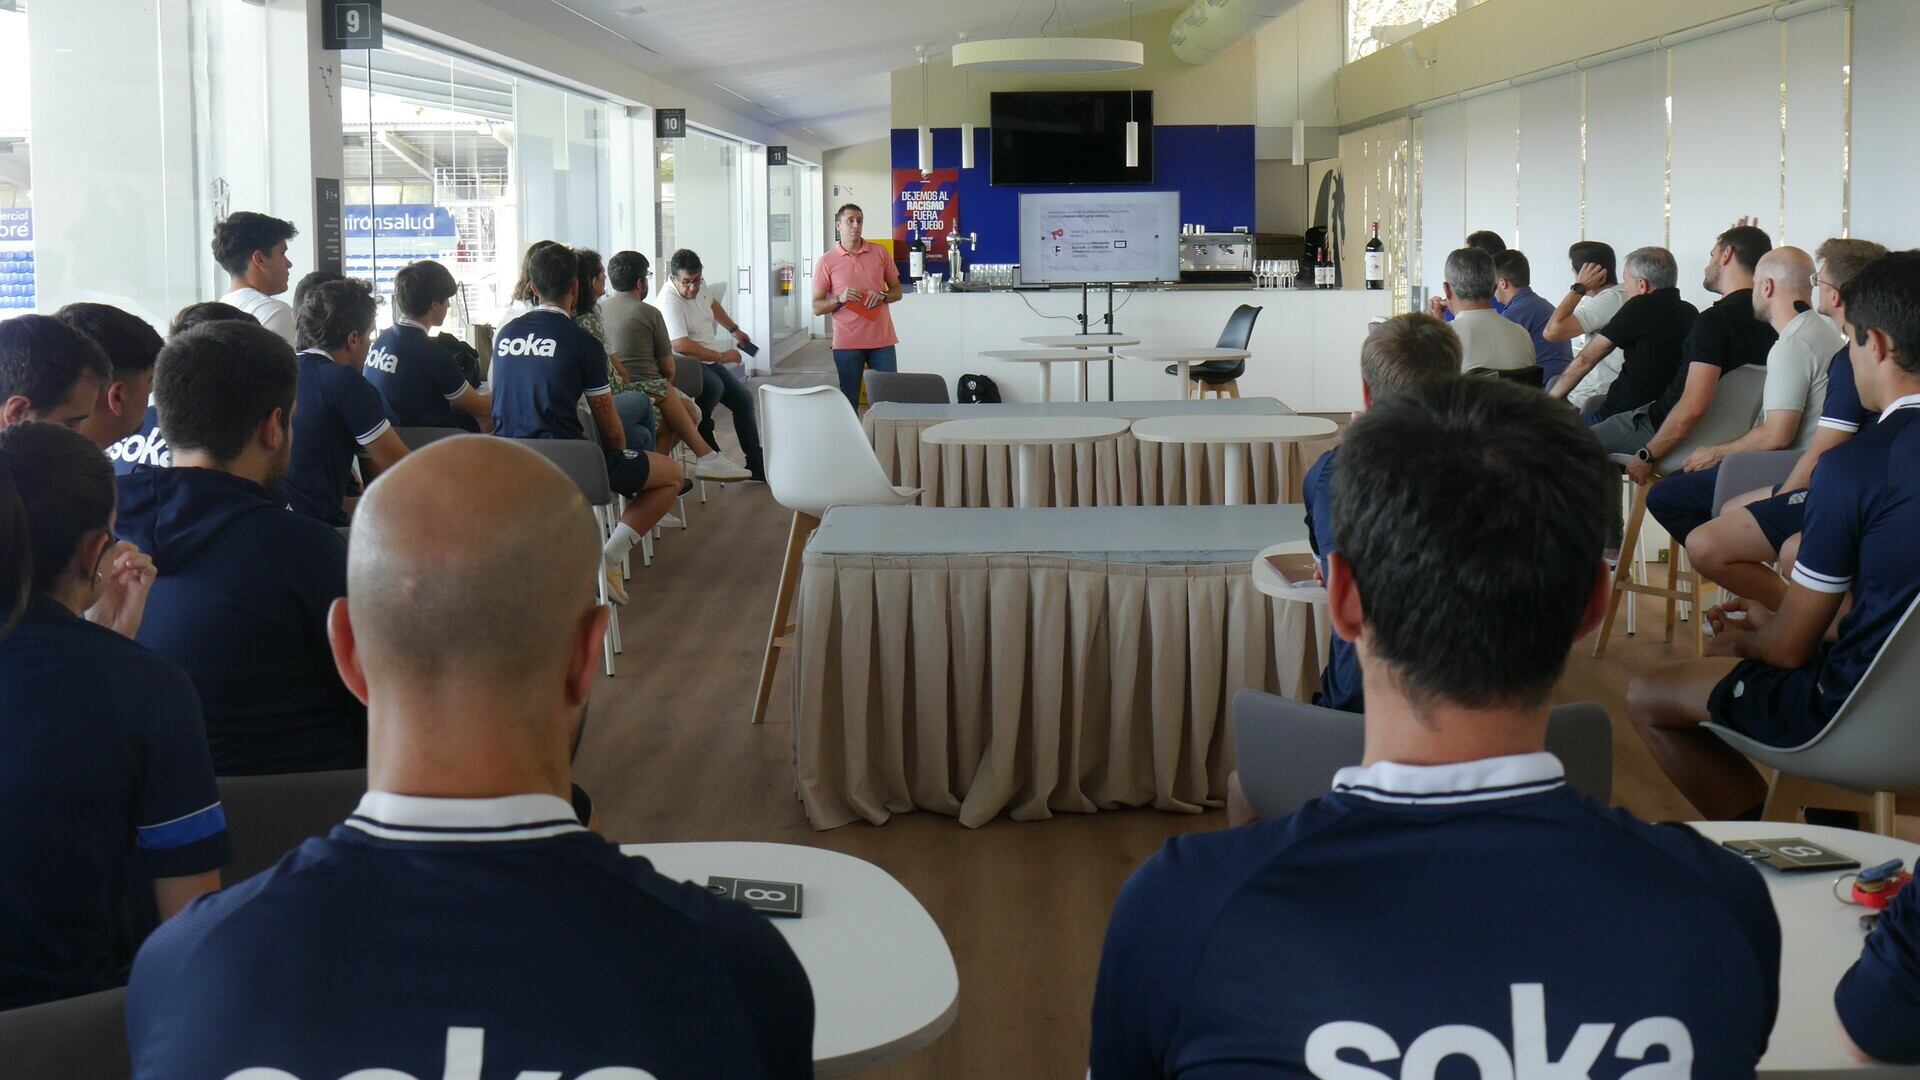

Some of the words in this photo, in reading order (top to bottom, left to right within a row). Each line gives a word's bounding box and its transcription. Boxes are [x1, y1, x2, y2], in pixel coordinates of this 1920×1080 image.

[347, 10, 359, 33] 9
[664, 118, 678, 130] 10
[773, 152, 781, 161] 11
[902, 191, 938, 201] DEJEMOS
[938, 191, 949, 201] AL
[906, 201, 944, 211] RACISMO
[913, 210, 938, 220] FUERA
[920, 220, 944, 230] JUEGO
[497, 333, 557, 358] soka
[365, 346, 399, 374] oka
[1778, 846, 1823, 858] 8
[744, 888, 787, 902] 8
[1304, 982, 1694, 1080] soka
